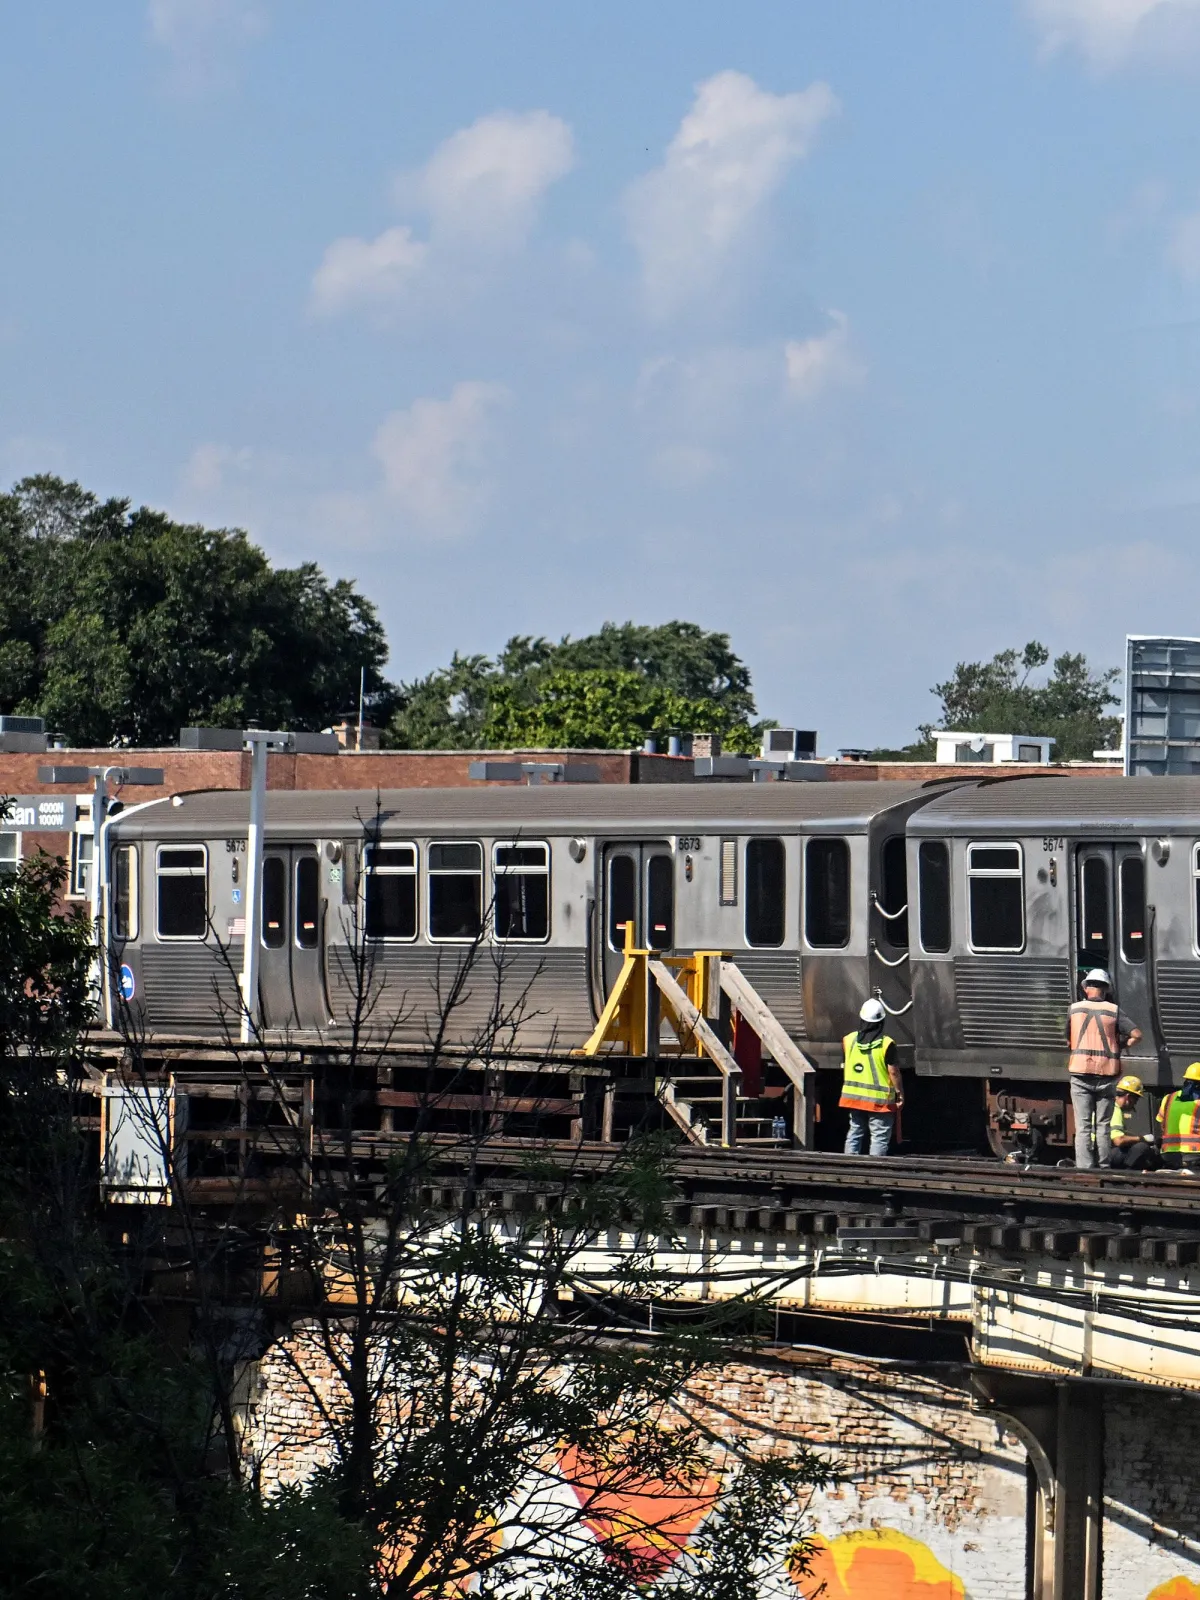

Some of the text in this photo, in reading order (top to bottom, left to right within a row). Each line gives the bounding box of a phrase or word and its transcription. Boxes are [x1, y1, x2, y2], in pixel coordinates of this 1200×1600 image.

[38, 802, 64, 814] 4000N
[38, 814, 64, 826] 1000W
[226, 840, 246, 853] 5673
[678, 837, 701, 851] 5673
[1042, 837, 1064, 852] 5674
